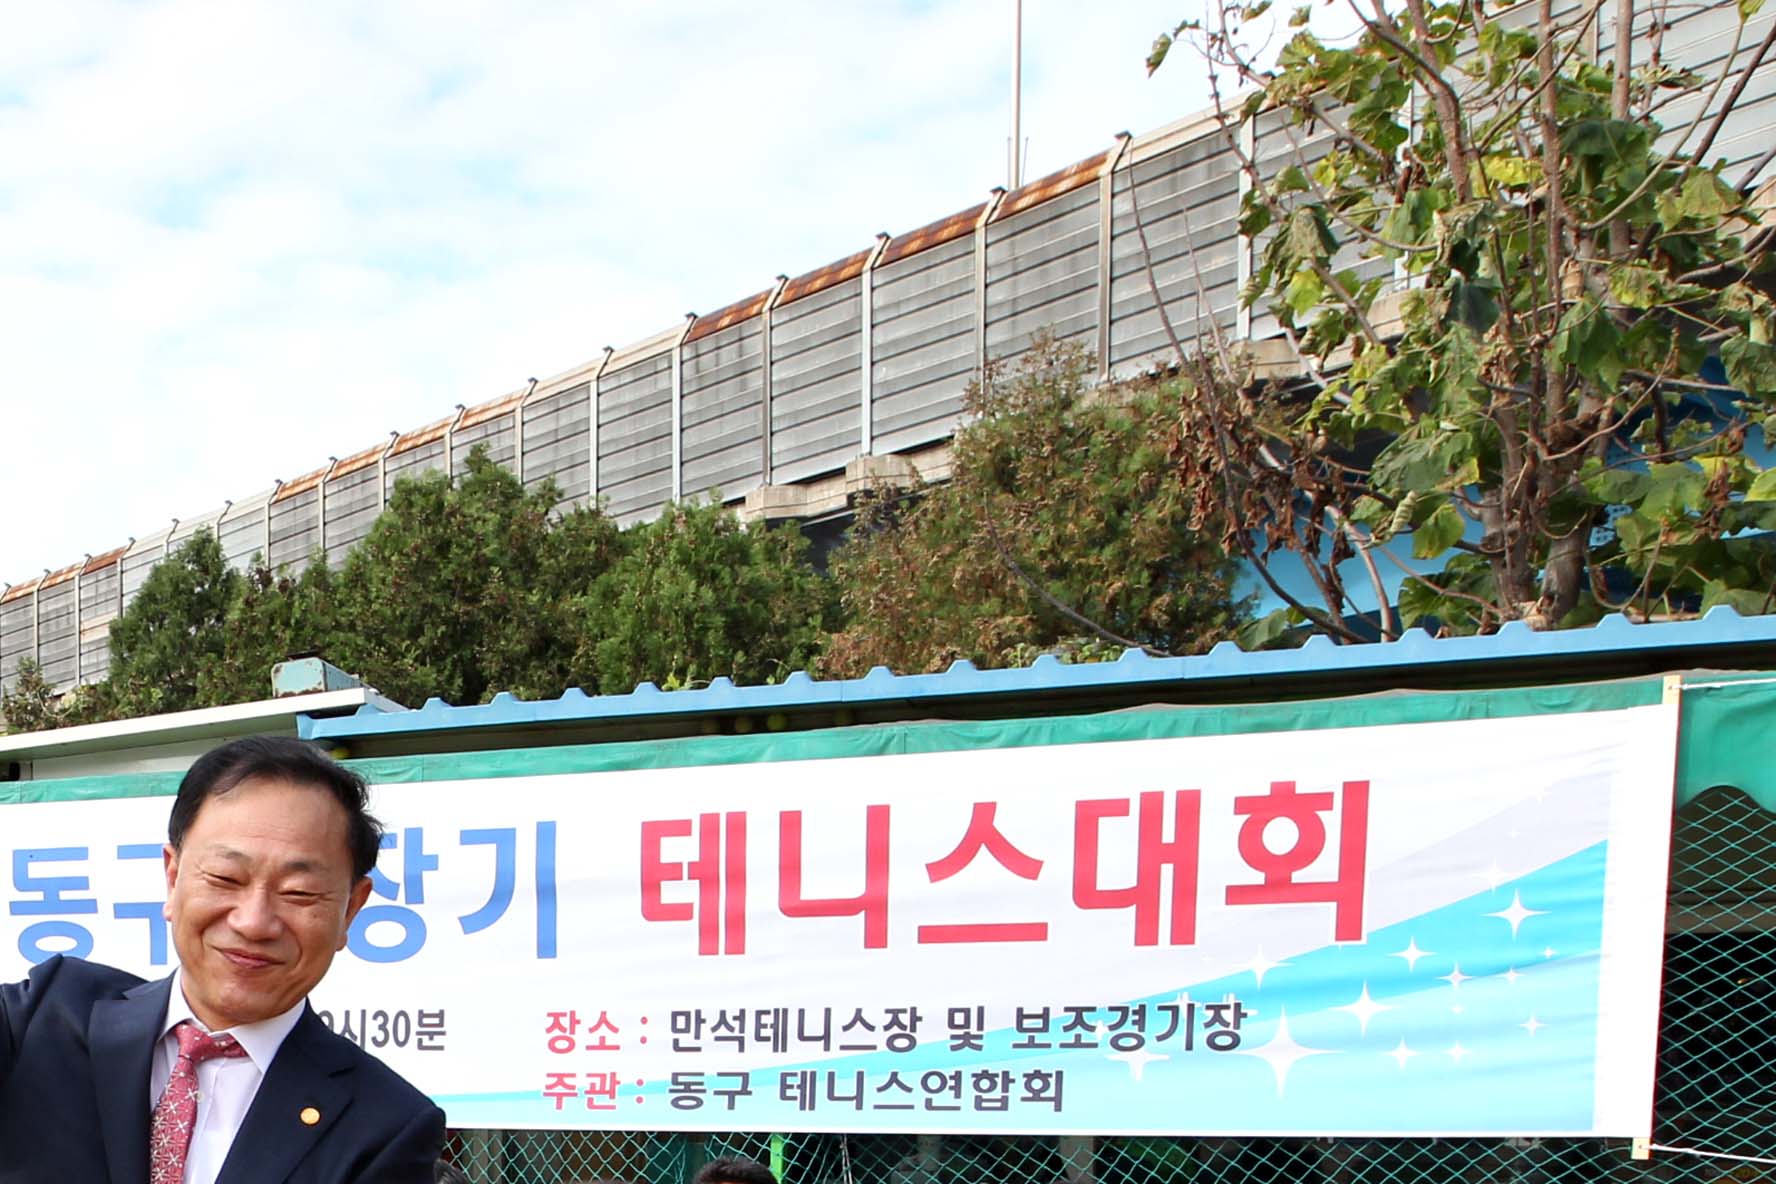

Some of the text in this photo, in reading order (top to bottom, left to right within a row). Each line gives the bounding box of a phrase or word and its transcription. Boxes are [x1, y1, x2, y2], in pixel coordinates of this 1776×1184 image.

[9, 821, 557, 965] 동구장기
[640, 780, 1370, 955] 테니스대회
[670, 1006, 923, 1053] 만석테니스장
[947, 1005, 985, 1052] 및
[1012, 1002, 1248, 1053] 보조경기장
[669, 1072, 752, 1111] 동구
[779, 1069, 1064, 1112] 테니스연합회
